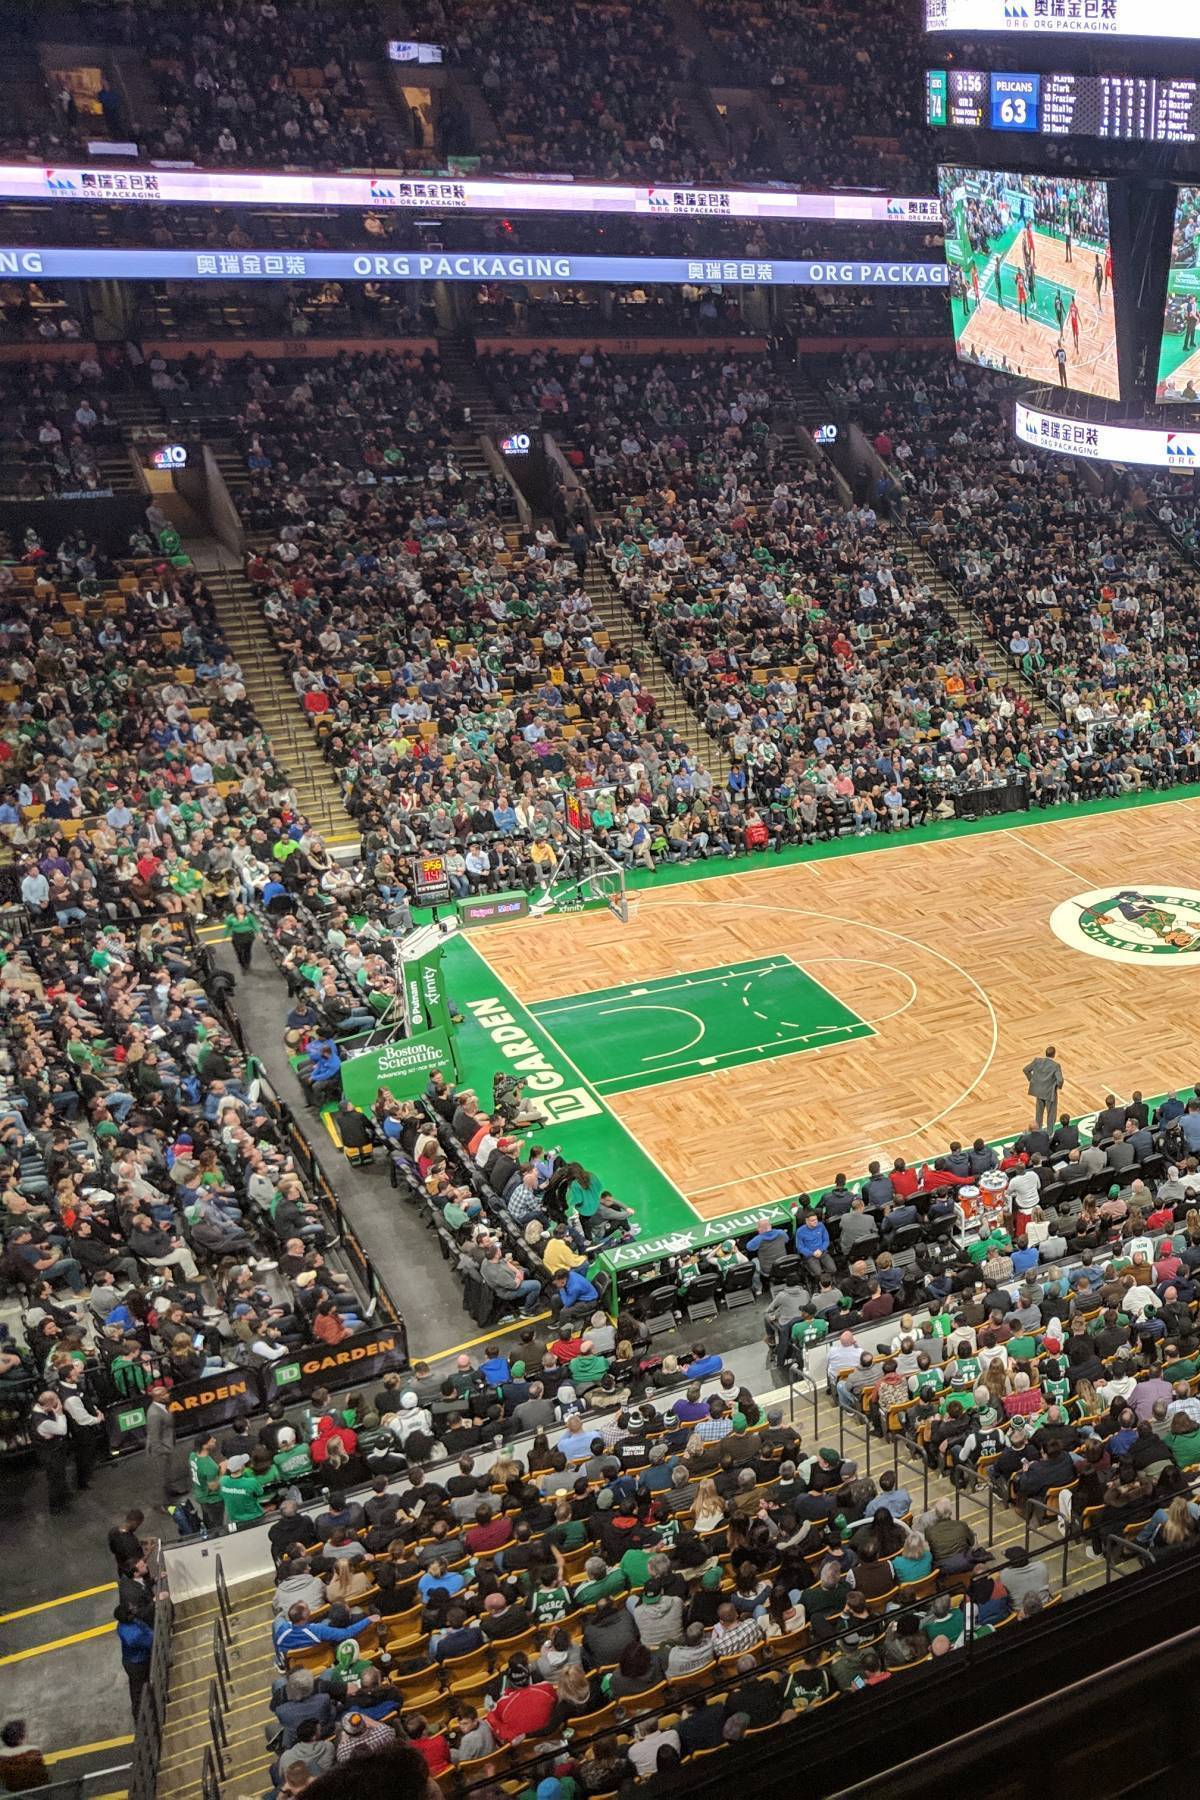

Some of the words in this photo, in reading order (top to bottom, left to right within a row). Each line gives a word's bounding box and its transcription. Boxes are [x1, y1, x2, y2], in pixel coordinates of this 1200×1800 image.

[1033, 20, 1053, 30] ORG
[1056, 20, 1118, 31] PACKAGING
[956, 75, 981, 92] 3:56
[996, 81, 1033, 92] PELICANS
[1052, 83, 1070, 92] Clark
[1172, 81, 1196, 90] PLAYER
[1052, 93, 1077, 103] Frazier
[1000, 98, 1027, 124] 63
[81, 173, 159, 191] 奥瑞金包装
[82, 190, 103, 198] ORG
[105, 191, 161, 199] PACKAGING
[398, 183, 465, 200] 奥瑞金包装
[673, 192, 730, 207] 奥瑞金包装
[0, 253, 43, 272] NG
[197, 255, 306, 275] 奥瑞金包装
[353, 256, 410, 276] ORG
[420, 257, 571, 278] PACKAGING
[688, 262, 772, 281] 奥瑞金包装
[809, 264, 853, 282] ORG
[822, 424, 837, 438] 10
[1041, 418, 1099, 446] 奥瑞金包装
[511, 434, 530, 449] 10
[1041, 438, 1052, 448] ORG
[1054, 441, 1099, 456] PACKAGING
[165, 446, 187, 463] 10
[422, 859, 442, 871] 3:56
[558, 904, 585, 914] xfinity
[1081, 921, 1154, 953] CELTICS
[423, 966, 441, 1006] xfinity
[410, 980, 421, 1015] Putnam
[385, 1043, 427, 1061] Boston
[465, 997, 565, 1091] GARDEN
[378, 1046, 443, 1071] Scientific
[377, 1069, 407, 1080] Advancing
[543, 1093, 586, 1121] TD
[704, 1206, 785, 1238] xfinity
[278, 1365, 300, 1383] TD
[303, 1339, 395, 1375] GARDEN
[121, 1410, 145, 1428] TD
[168, 1381, 246, 1414] ARDEN
[538, 1599, 566, 1613] PIERCE
